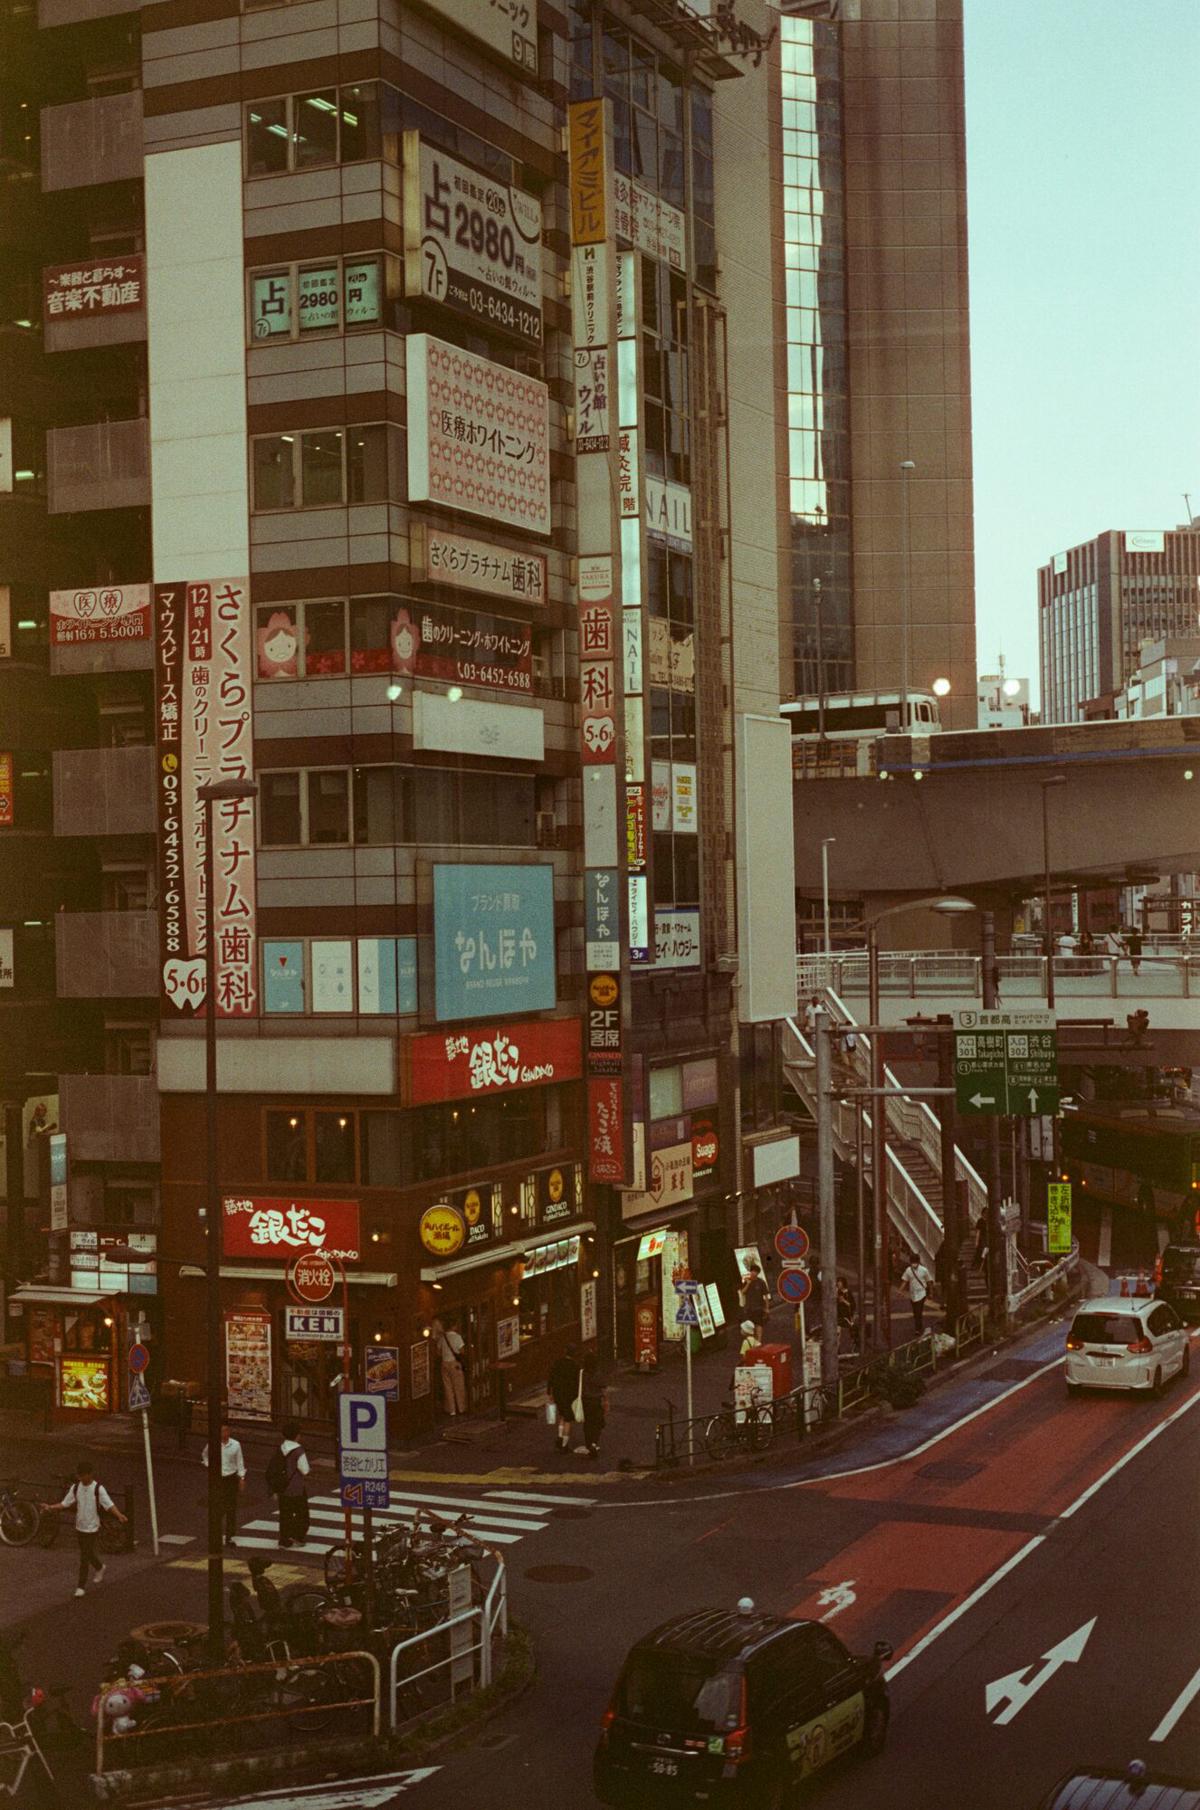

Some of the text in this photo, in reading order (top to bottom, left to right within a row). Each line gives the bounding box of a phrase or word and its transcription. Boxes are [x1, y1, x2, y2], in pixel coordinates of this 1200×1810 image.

[425, 163, 450, 238] 占
[425, 250, 443, 295] 7F
[47, 281, 140, 314] 音楽不動産
[262, 281, 285, 316] 占
[299, 291, 338, 309] 2980
[470, 288, 540, 339] 03-6434-1212
[593, 354, 607, 410] 占いの館
[441, 410, 536, 464] 医療ホワイトニング
[645, 490, 690, 534] NAIL
[431, 542, 542, 597] さくらプラチナム歯科
[79, 594, 119, 610] 医療
[160, 592, 180, 741] マウスピース矯正
[463, 662, 530, 688] 03-6452-6588
[582, 608, 612, 709] 歯科
[626, 628, 639, 691] NAIL
[163, 775, 180, 952] 03-6452-6588
[590, 1010, 619, 1028] 2F
[965, 1015, 972, 1025] 3
[469, 1030, 519, 1089] 銀だこ
[520, 1063, 554, 1082] GINDACO
[959, 1038, 974, 1046] 入口
[959, 1048, 975, 1056] 301
[1009, 1048, 1027, 1056] 302
[1010, 1035, 1052, 1048] 入口 渋谷
[248, 1203, 326, 1247] 銀だこ
[297, 1268, 331, 1287] 消火栓
[293, 1316, 335, 1332] KEN
[349, 1401, 378, 1443] P
